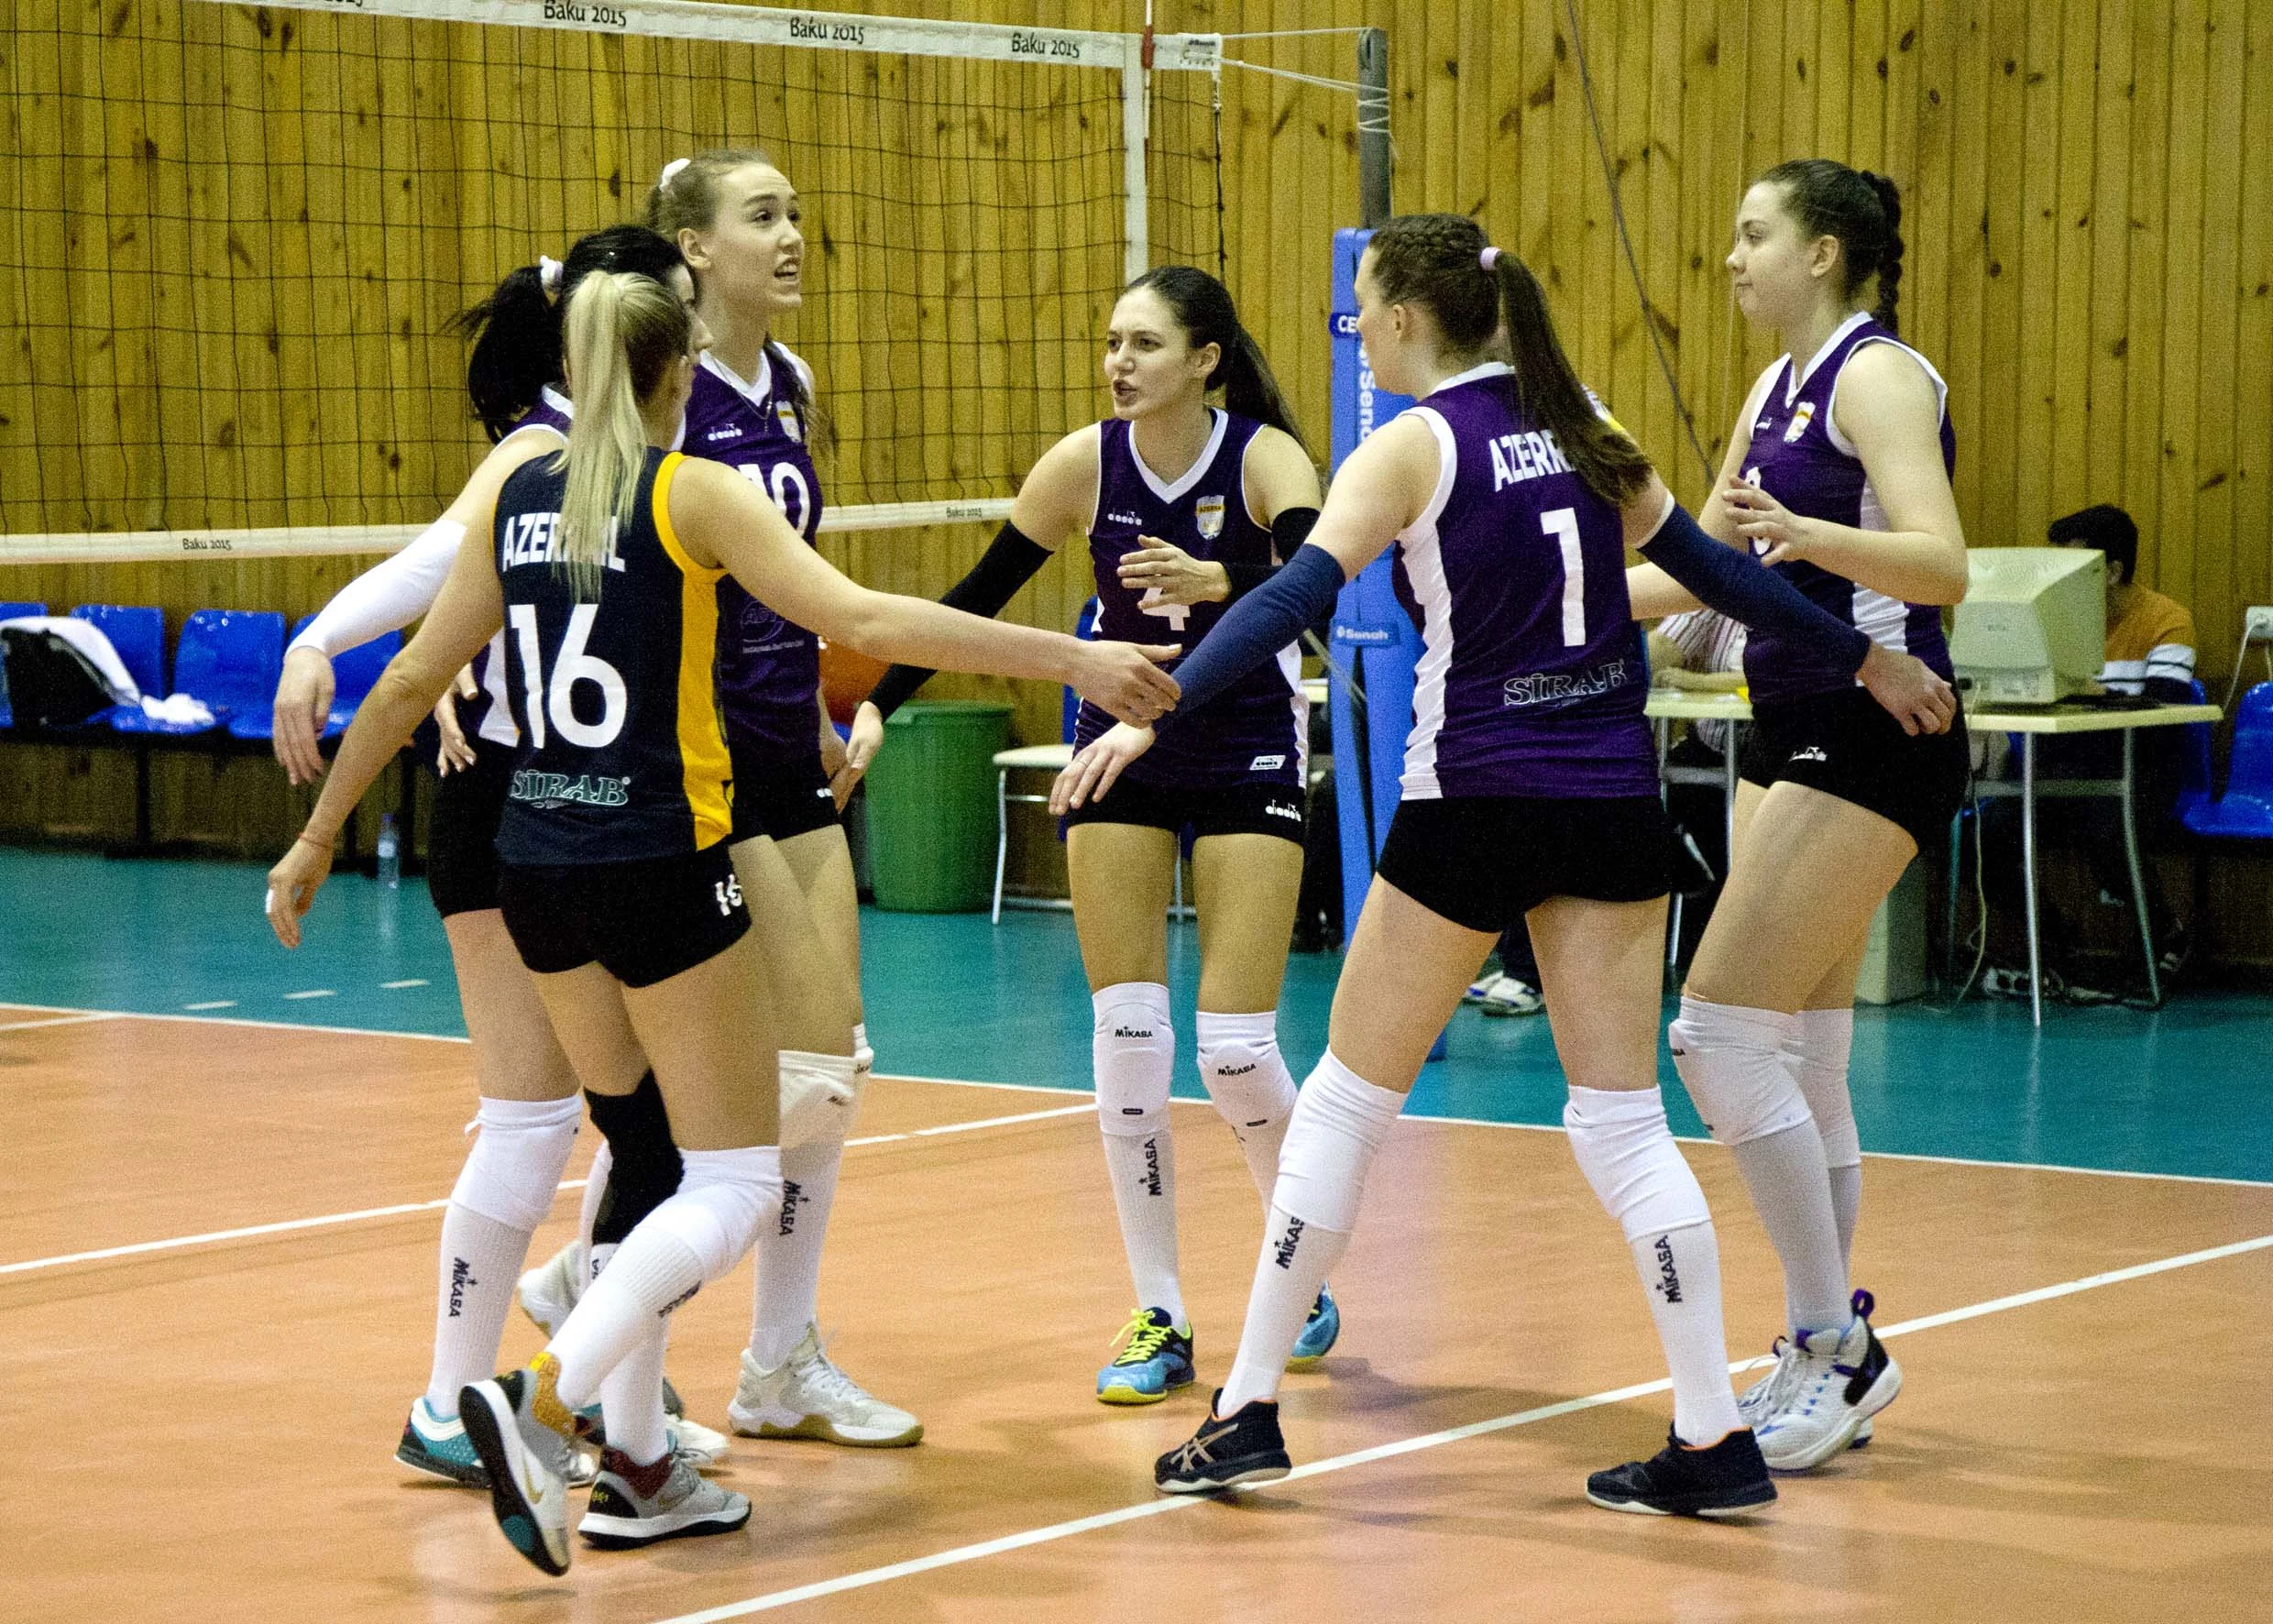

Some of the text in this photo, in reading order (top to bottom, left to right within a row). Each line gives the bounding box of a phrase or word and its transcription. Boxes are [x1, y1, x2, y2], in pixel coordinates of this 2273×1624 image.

[544, 0, 627, 27] Baku 2015
[789, 16, 864, 45] Baku 2015
[1011, 32, 1080, 59] Baku 2015
[1359, 369, 1377, 444] Seno
[946, 506, 964, 519] Baku
[182, 537, 232, 551] Baku 2015
[502, 512, 626, 573] AZERL
[1540, 507, 1587, 647] 1
[510, 604, 627, 750] 16
